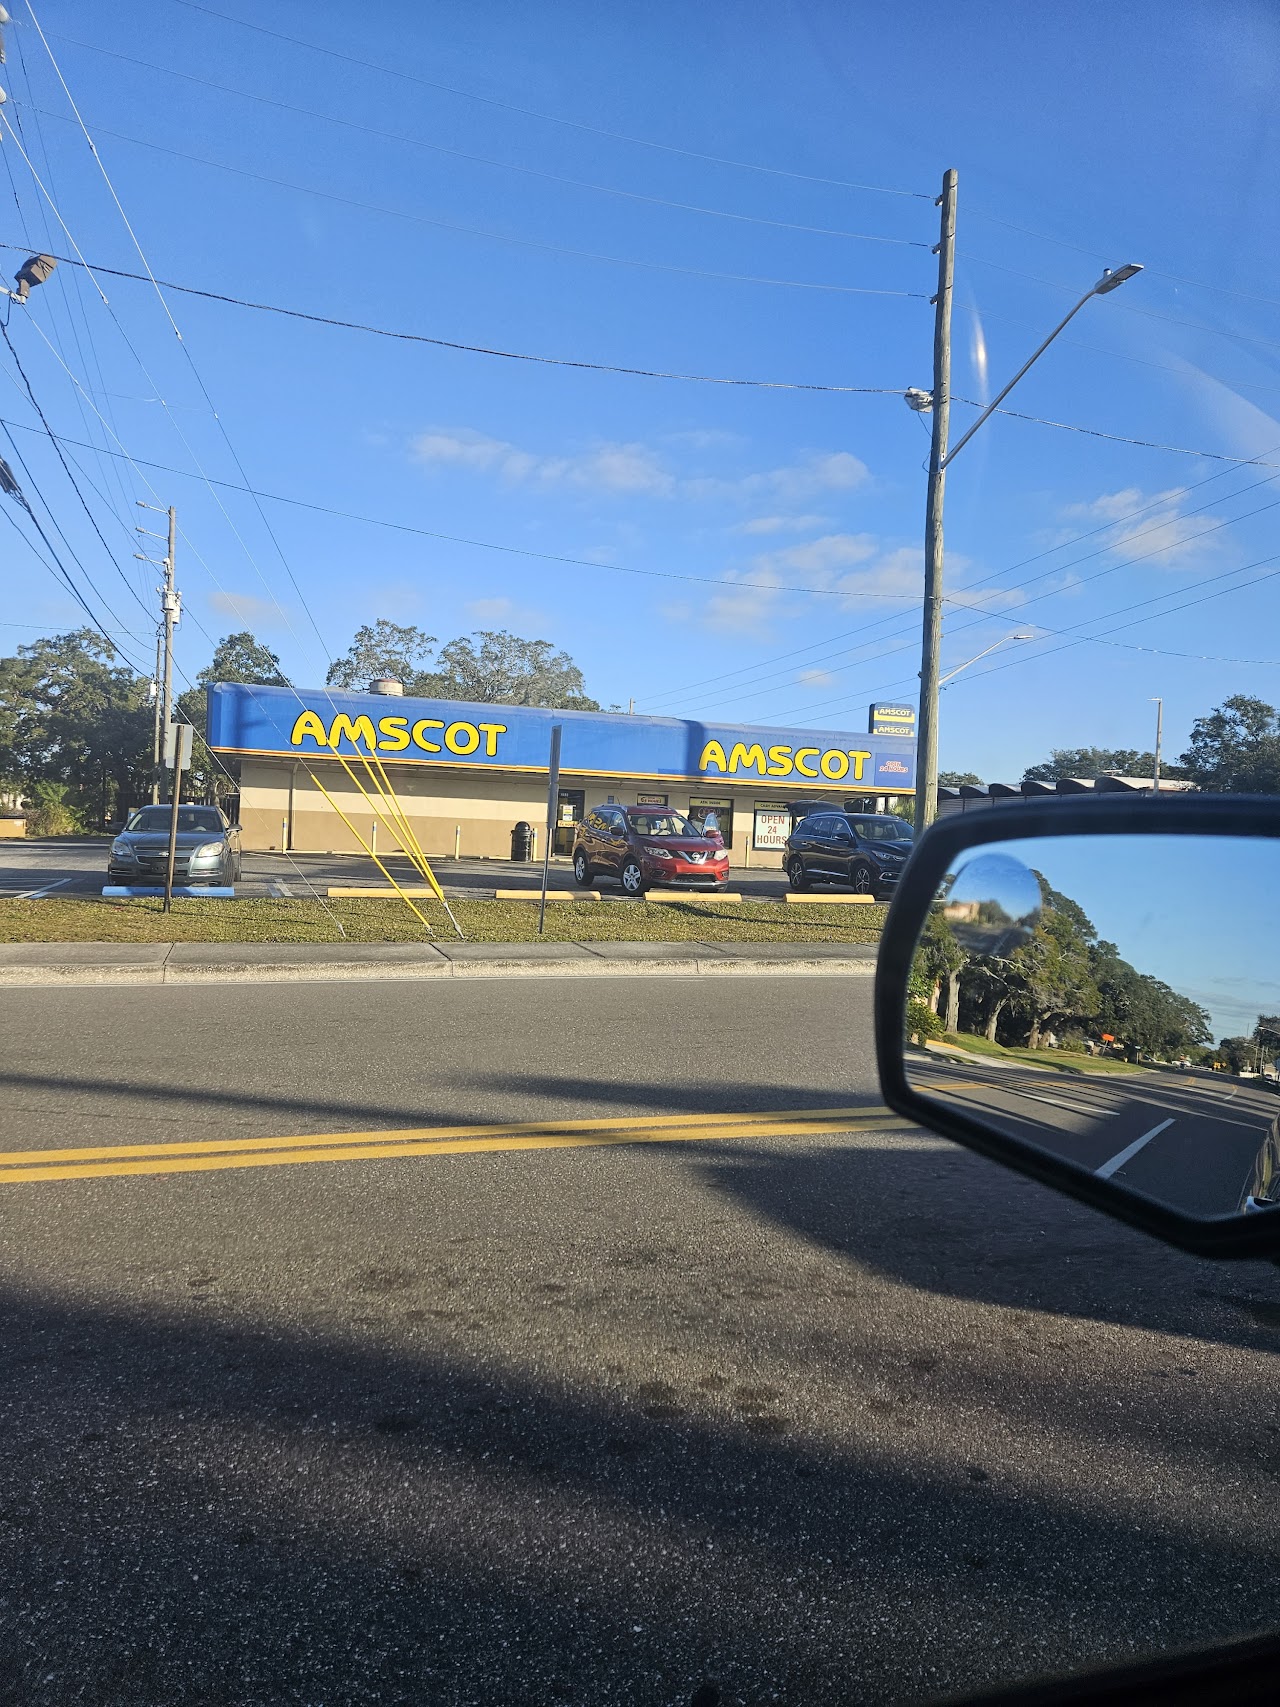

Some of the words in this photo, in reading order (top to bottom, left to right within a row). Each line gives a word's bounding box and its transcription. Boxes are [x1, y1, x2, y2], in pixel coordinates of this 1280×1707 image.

[291, 710, 507, 757] AMSCOT
[699, 739, 872, 781] AMSCOT
[761, 814, 784, 824] OPEN
[768, 826, 777, 834] 24
[757, 835, 787, 844] HOURS
